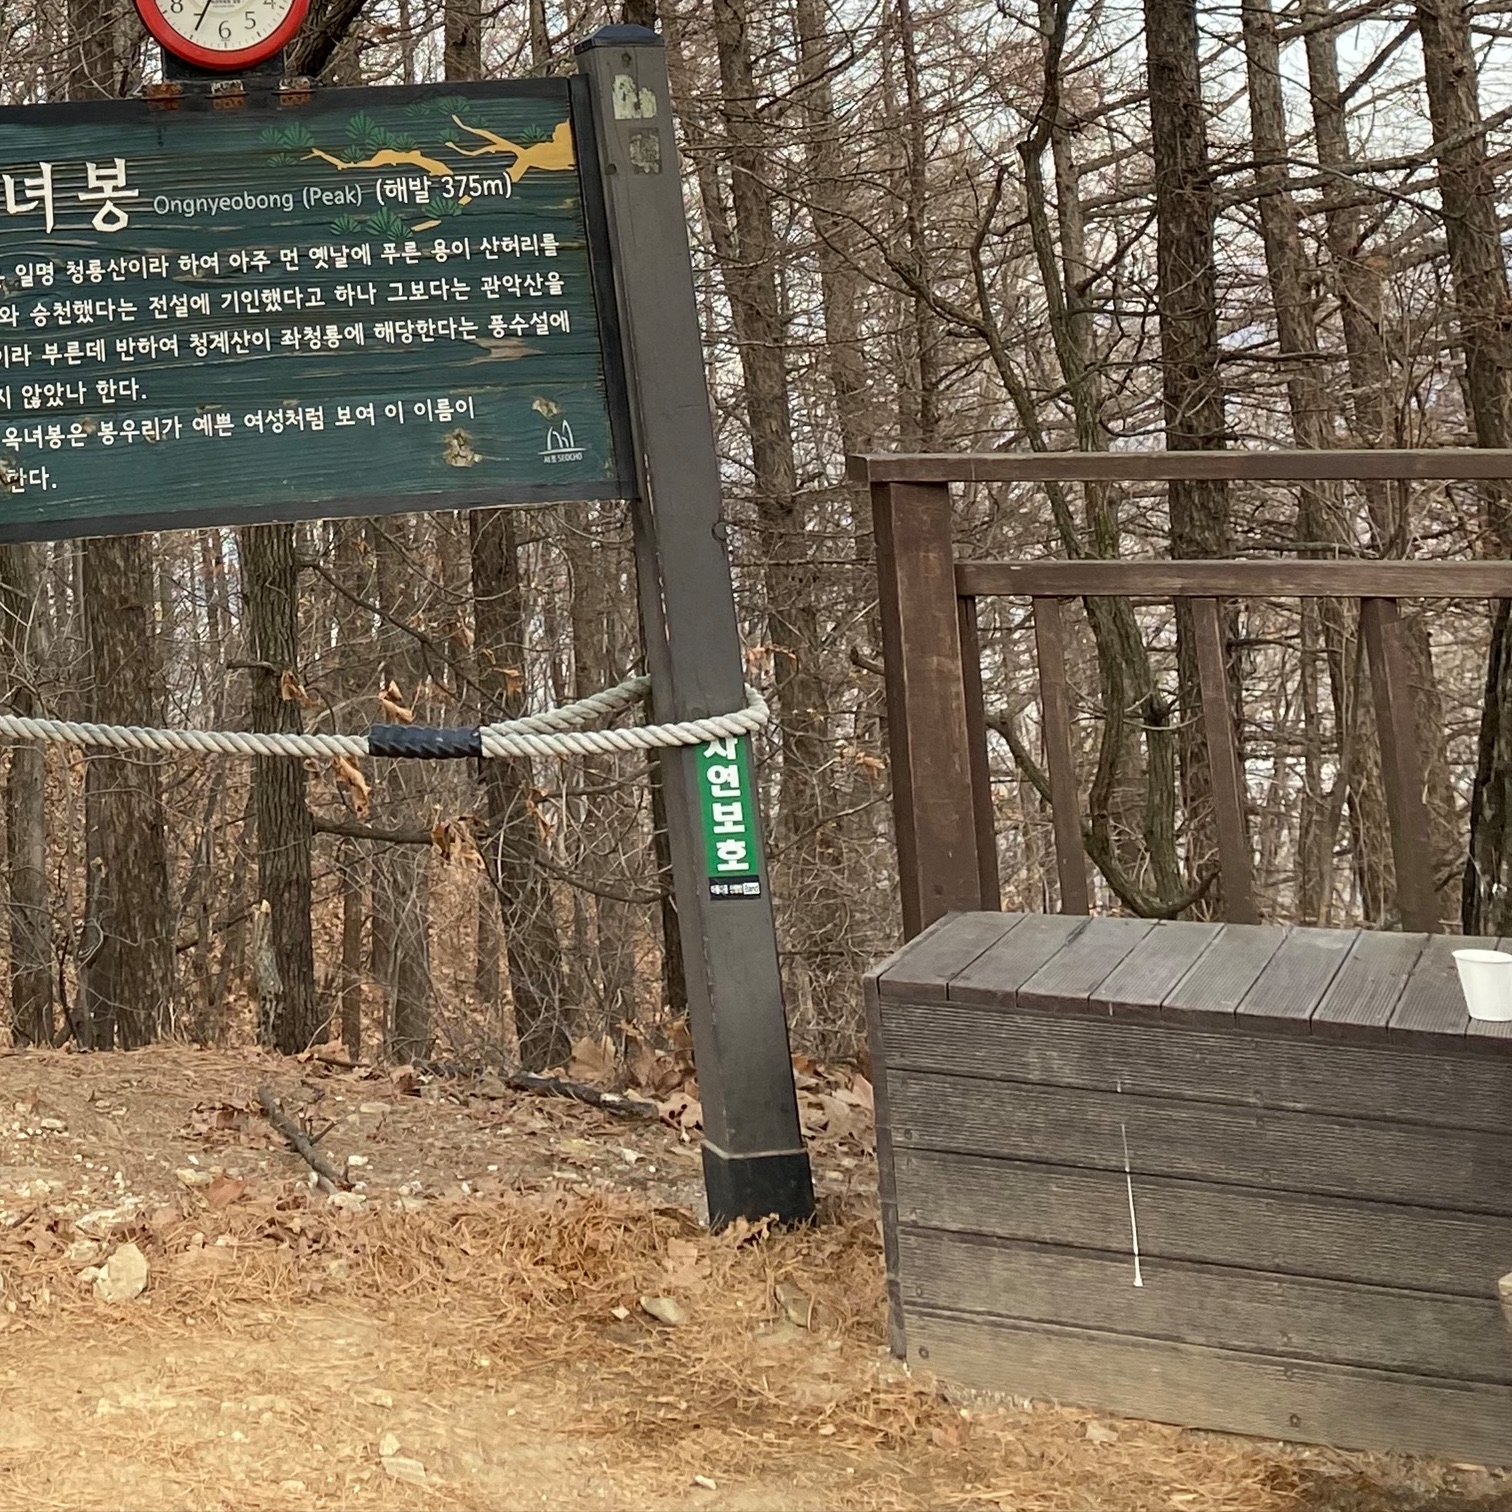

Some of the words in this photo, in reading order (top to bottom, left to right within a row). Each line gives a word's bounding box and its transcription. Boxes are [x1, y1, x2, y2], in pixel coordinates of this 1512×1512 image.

[218, 20, 232, 39] 6
[244, 12, 256, 29] 5
[303, 184, 367, 209] (Peak)
[376, 176, 431, 205] (해발
[441, 166, 511, 205] 375m)
[15, 262, 53, 287] 일명
[67, 255, 169, 284] 청룡산이라
[178, 252, 219, 275] 하여
[229, 250, 270, 273] 아주
[280, 247, 298, 271] 먼
[309, 243, 371, 269] 옛날에
[381, 242, 421, 264] 푸른
[431, 238, 470, 262] 용이
[480, 234, 559, 259] 산허리를
[30, 298, 137, 326] 승천했다는
[149, 293, 210, 318] 전설에
[221, 287, 325, 313] 기인했다고
[334, 283, 376, 306] 하나
[387, 278, 470, 301] 그보다는
[481, 272, 564, 298] 관악산을
[42, 339, 105, 365] 부른데
[116, 334, 178, 361] 반하여
[190, 328, 270, 356] 청계산이
[281, 323, 364, 349] 좌청룡에
[373, 317, 479, 343] 해당한다는
[488, 310, 569, 337] 풍수설에
[22, 381, 86, 408] 않았나
[96, 378, 146, 403] 한다.
[98, 416, 182, 445] 봉우리가
[192, 413, 234, 436] 예쁜
[244, 406, 324, 433] 여성처럼
[335, 403, 375, 425] 보여
[385, 401, 403, 424] 이
[414, 396, 474, 421] 이름이
[703, 737, 749, 872] 자연보호
